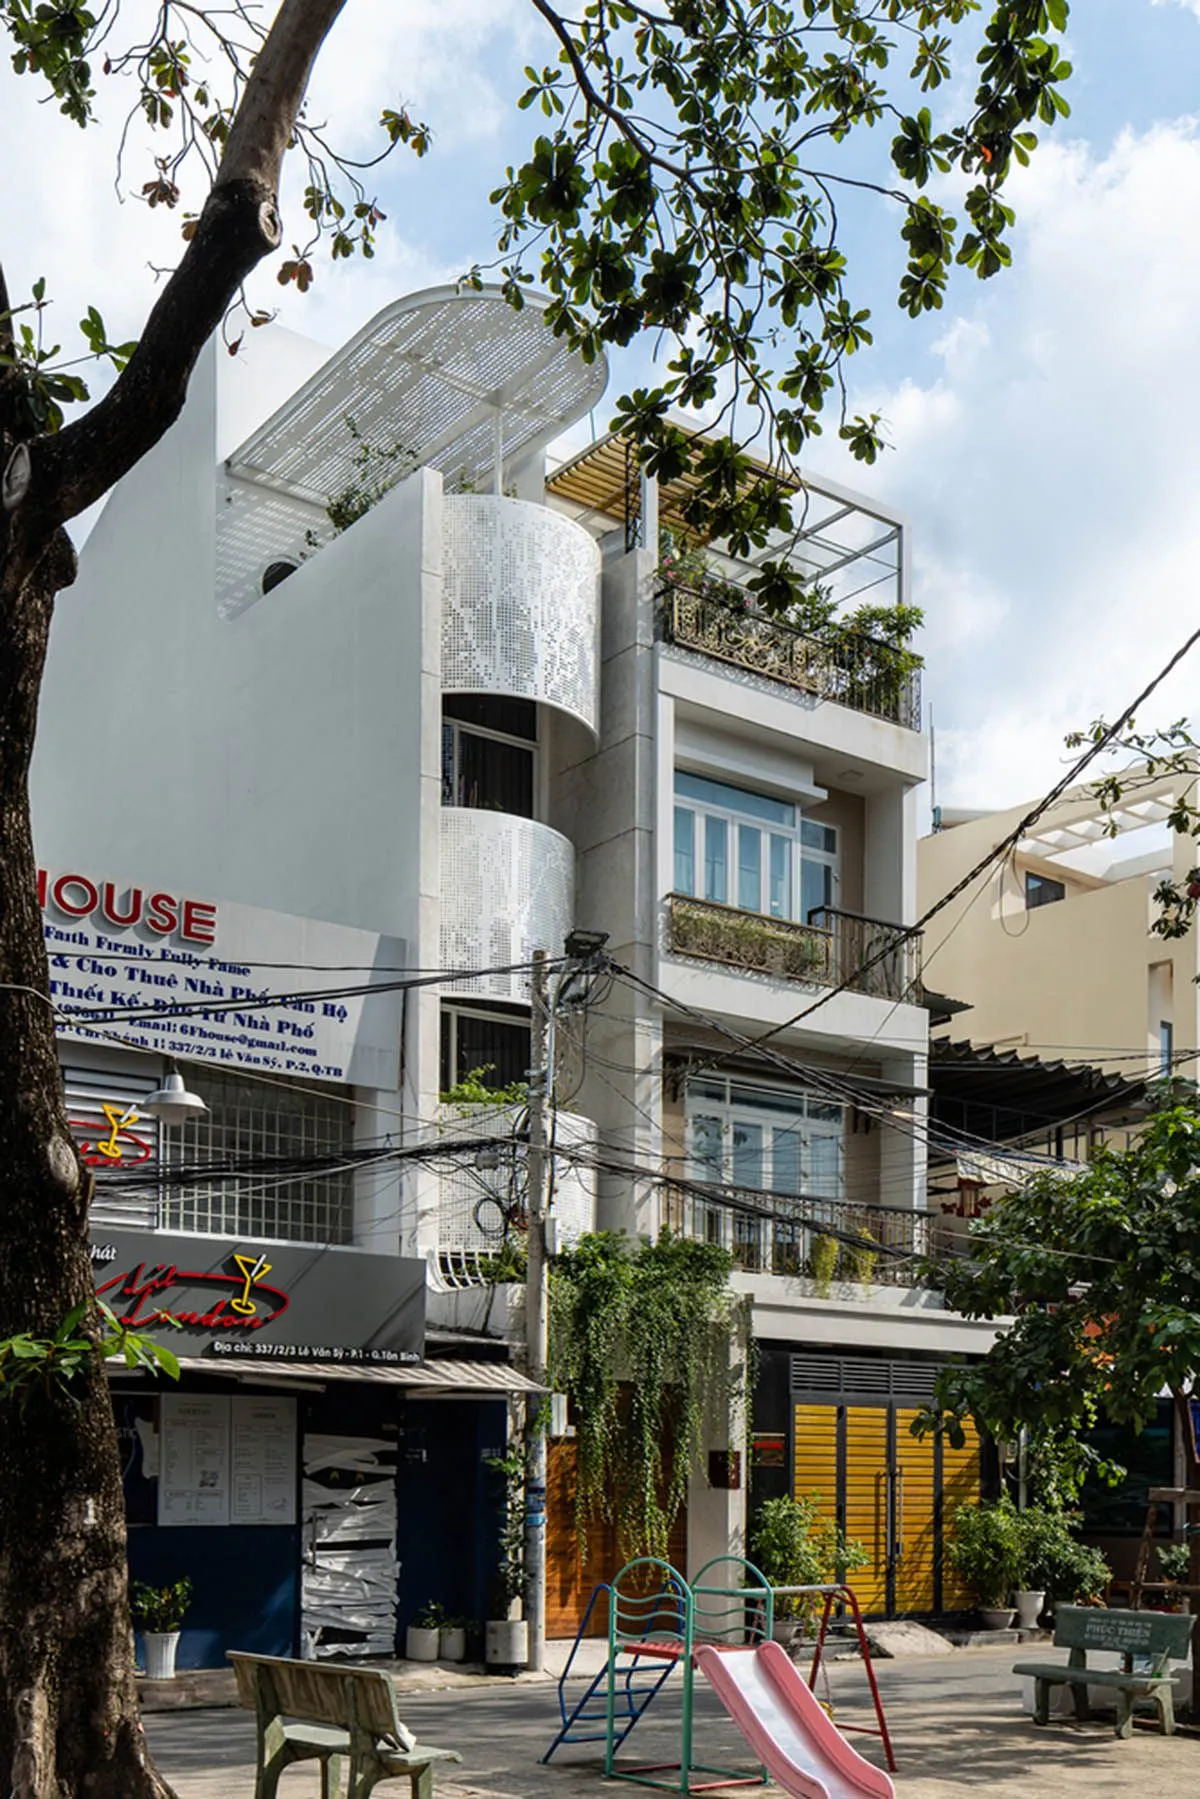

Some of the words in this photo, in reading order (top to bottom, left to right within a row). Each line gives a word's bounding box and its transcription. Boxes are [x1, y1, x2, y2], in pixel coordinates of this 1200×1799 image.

[96, 935, 155, 960] Firmly
[208, 957, 252, 977] Fame
[51, 953, 70, 969] &
[76, 956, 117, 977] Cho
[124, 965, 178, 989] Thuê
[184, 976, 225, 998] Nhà
[322, 1002, 348, 1024] Hộ
[49, 979, 105, 1003] Thiết
[110, 991, 141, 1007] Kế
[233, 1012, 271, 1032] Nhà
[277, 1020, 315, 1039] Phố
[168, 1040, 217, 1058] 337/2/3
[311, 1064, 344, 1077] Q.TB
[180, 1023, 318, 1057] 6Fhouse@gmail.com
[255, 1344, 297, 1357] 337/2/3
